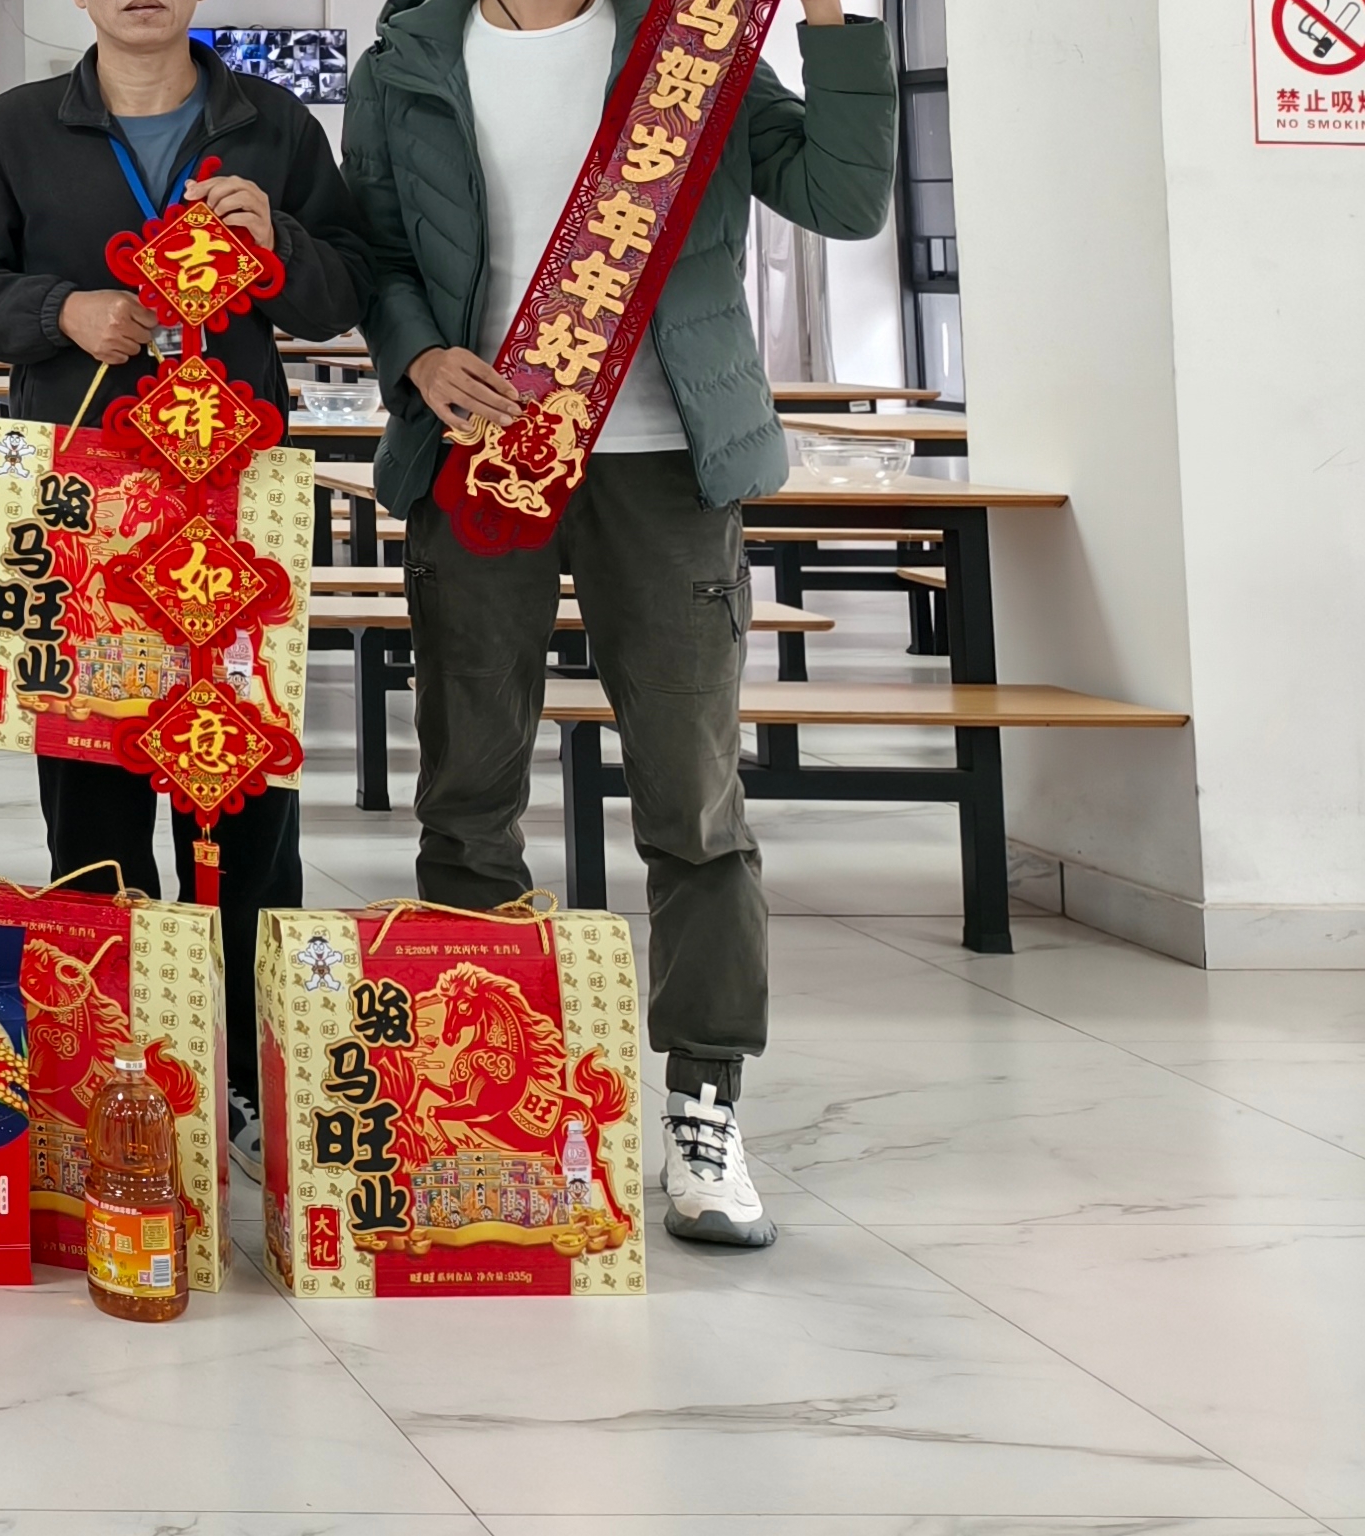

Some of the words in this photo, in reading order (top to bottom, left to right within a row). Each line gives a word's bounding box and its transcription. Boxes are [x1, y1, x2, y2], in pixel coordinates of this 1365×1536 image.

[1277, 119, 1299, 128] NO
[164, 229, 231, 292] 吉
[158, 384, 225, 447] 祥
[169, 541, 234, 605] 如
[67, 736, 111, 750] 旺旺系列
[172, 709, 239, 773] 意
[583, 927, 599, 941] 旺
[343, 952, 359, 966] 旺
[559, 951, 575, 965] 旺
[614, 951, 630, 965] 旺
[589, 975, 605, 989] 旺
[293, 999, 309, 1013] 旺
[564, 998, 580, 1012] 旺
[618, 998, 634, 1012] 旺
[321, 1022, 337, 1036] 旺
[593, 1022, 609, 1036] 旺
[295, 1045, 311, 1059] 旺
[620, 1044, 636, 1058] 旺
[296, 1092, 312, 1106] 旺
[314, 983, 412, 1232] 骏马旺业
[524, 1095, 557, 1124] 旺
[623, 1136, 639, 1150] 旺
[299, 1185, 315, 1199] 旺
[624, 1182, 640, 1196] 旺
[312, 1215, 336, 1262] 大礼
[601, 1253, 617, 1267] 旺
[302, 1278, 318, 1292] 旺
[357, 1278, 373, 1292] 旺
[574, 1275, 590, 1289] 旺
[627, 1274, 643, 1288] 旺
